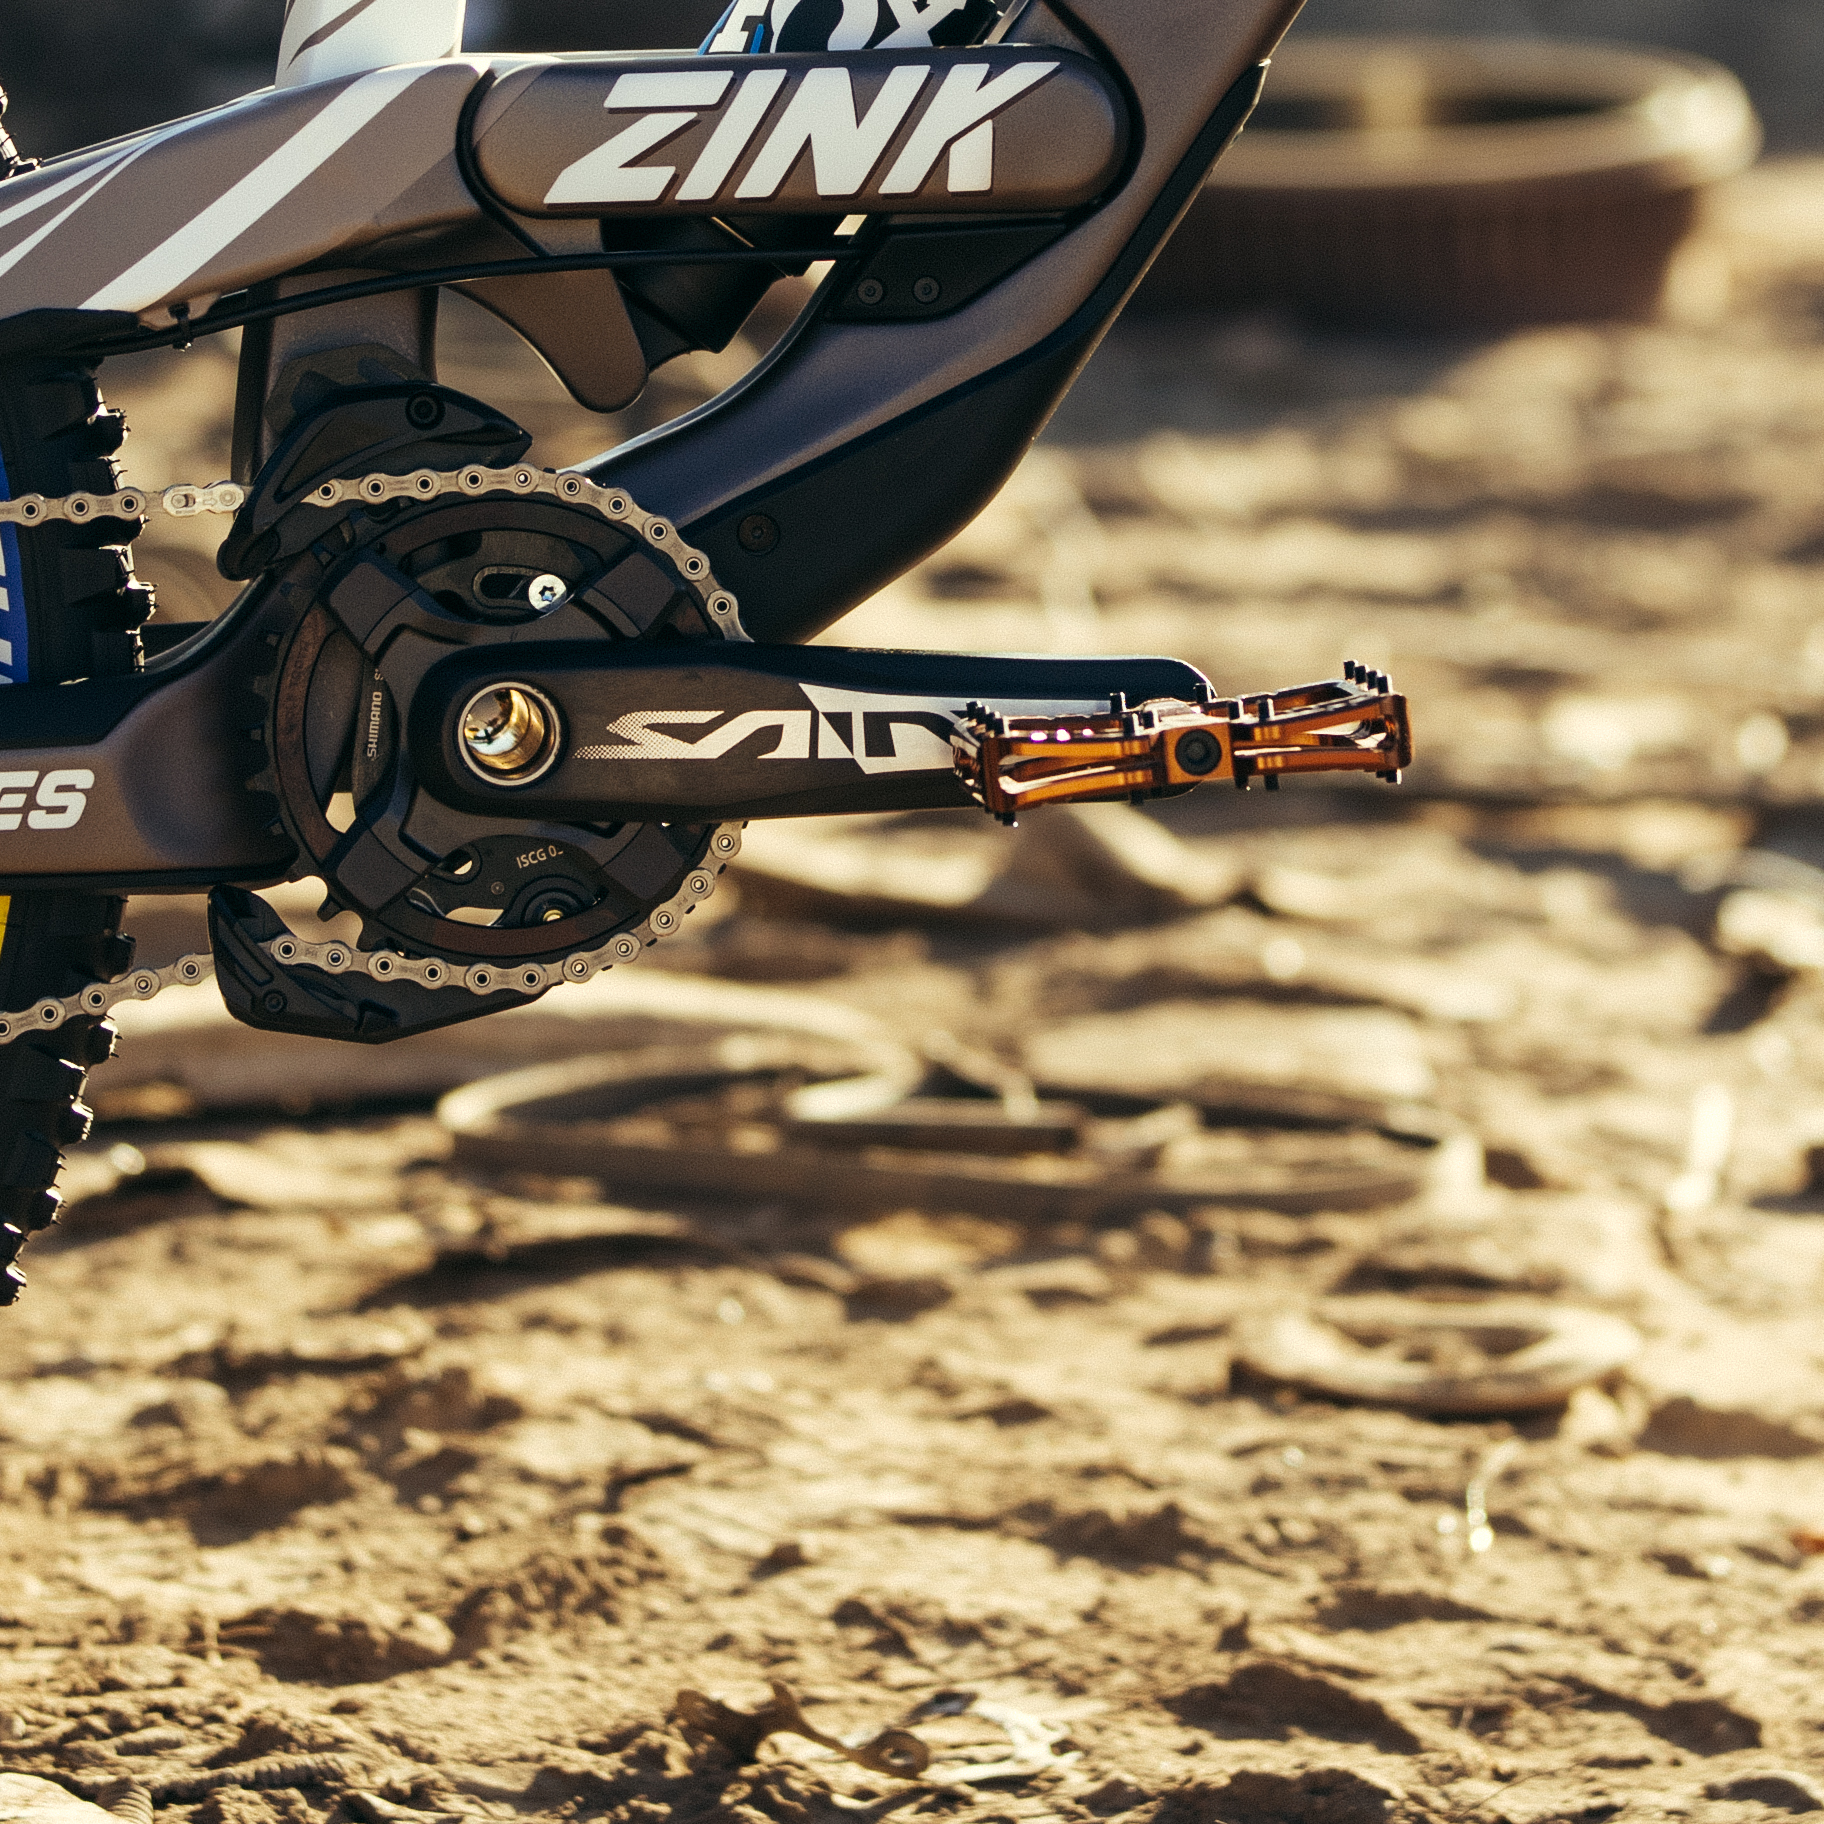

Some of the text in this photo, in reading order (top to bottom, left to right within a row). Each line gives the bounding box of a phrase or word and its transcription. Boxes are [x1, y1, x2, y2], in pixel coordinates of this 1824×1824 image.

[543, 61, 1061, 205] ZINK
[367, 691, 383, 758] SHIMANO
[516, 844, 564, 869] ISCG 0
